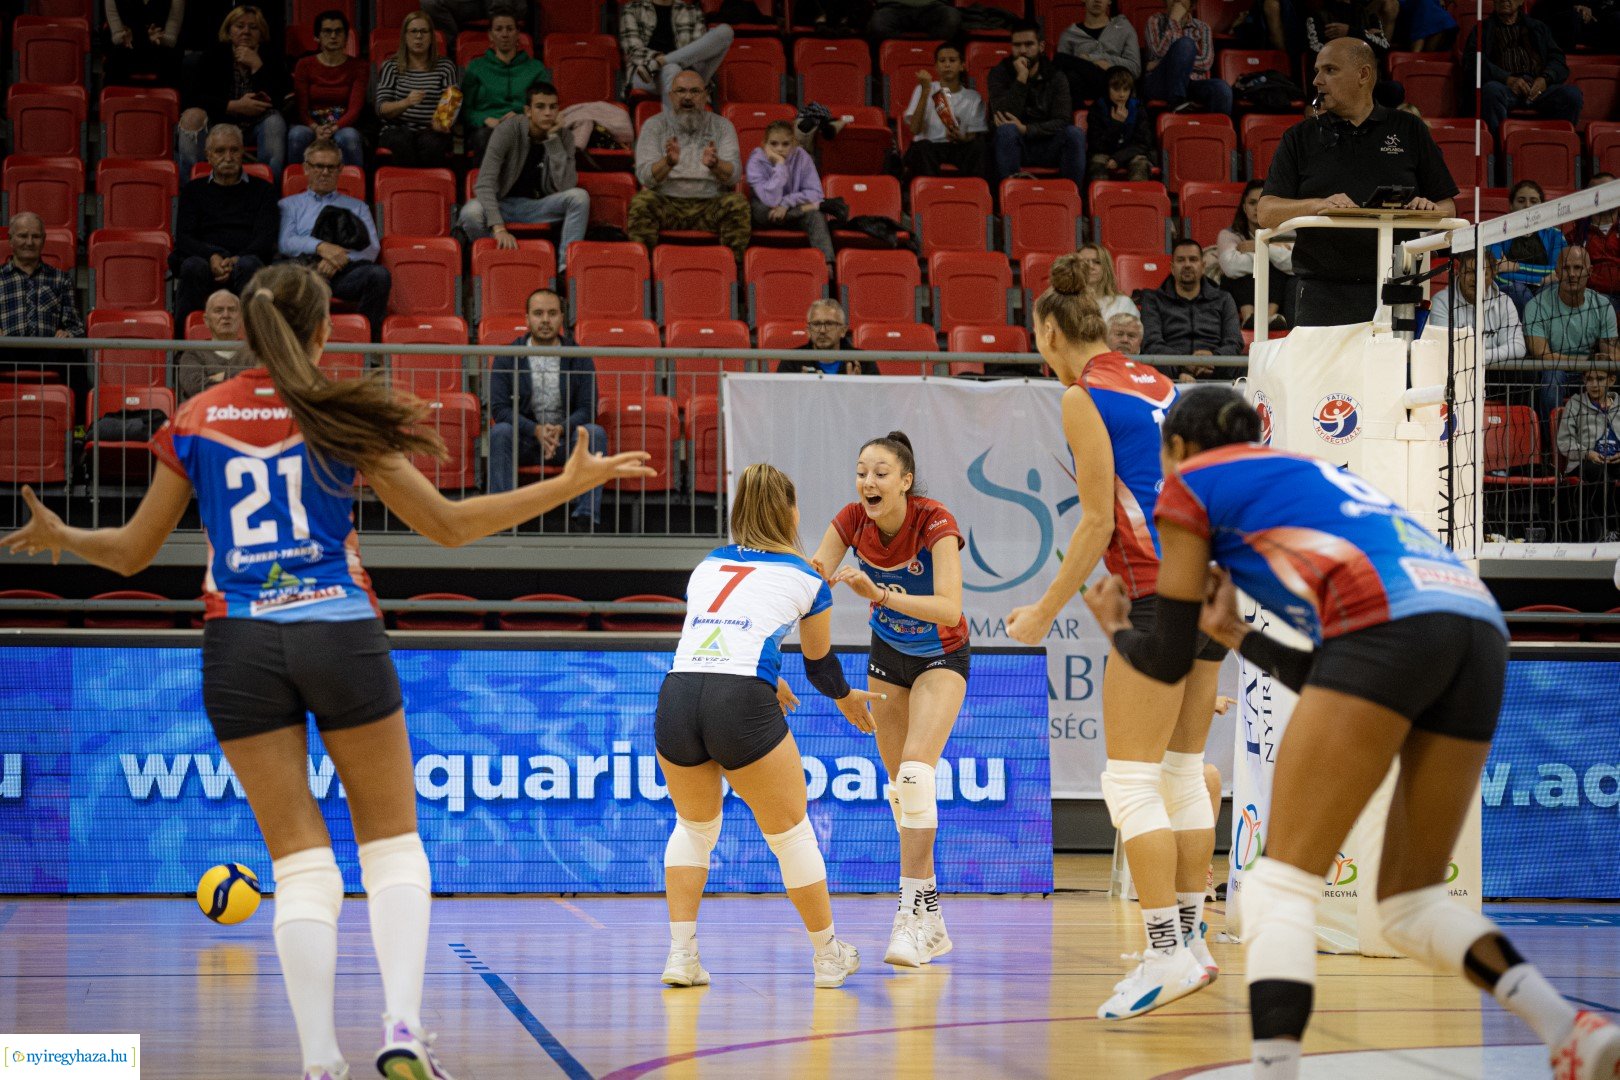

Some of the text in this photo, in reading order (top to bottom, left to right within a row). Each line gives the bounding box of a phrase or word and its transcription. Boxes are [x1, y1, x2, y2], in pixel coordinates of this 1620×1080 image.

[1326, 394, 1353, 403] FATUM
[206, 404, 294, 422] Zaborow
[224, 455, 310, 547] 21
[707, 564, 757, 613] 7
[969, 616, 1080, 640] MAAR
[1050, 713, 1098, 740] SÉG
